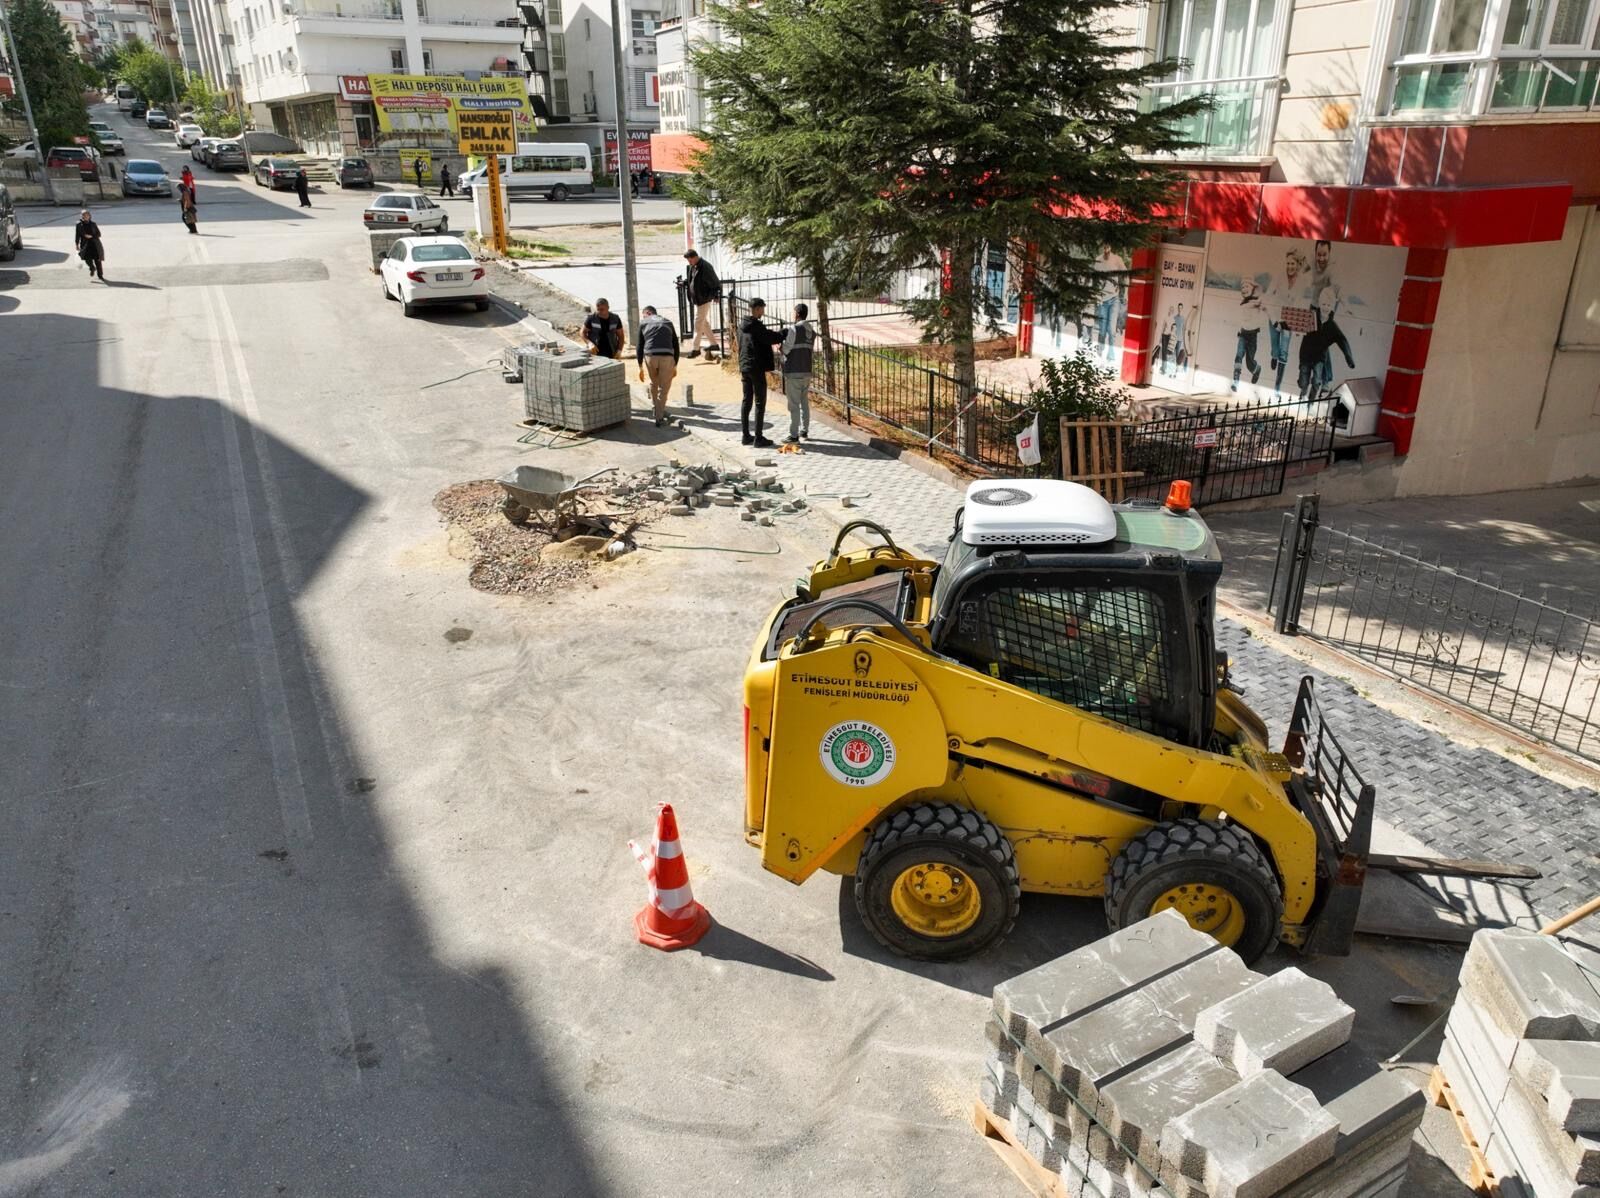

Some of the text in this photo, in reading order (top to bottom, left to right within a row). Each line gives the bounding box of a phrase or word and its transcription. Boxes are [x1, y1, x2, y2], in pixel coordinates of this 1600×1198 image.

[392, 81, 414, 90] HALI
[417, 82, 453, 92] DEPOSU
[456, 82, 477, 92] HALI
[480, 83, 506, 93] FUARI
[459, 112, 511, 124] MANSUROĞLU
[461, 127, 512, 140] EMLAK
[631, 132, 649, 140] AVM
[1163, 260, 1174, 271] BAY
[1178, 262, 1196, 274] BAYAN
[1161, 276, 1179, 288] ÇOCUK
[791, 673, 919, 692] ETİMESGUT BELEDİYESİ
[853, 690, 911, 703] MÜDÜRLÜĞÜ
[823, 723, 895, 763] ETİMESGUT BELEDİYESİ
[845, 776, 865, 785] 1990
